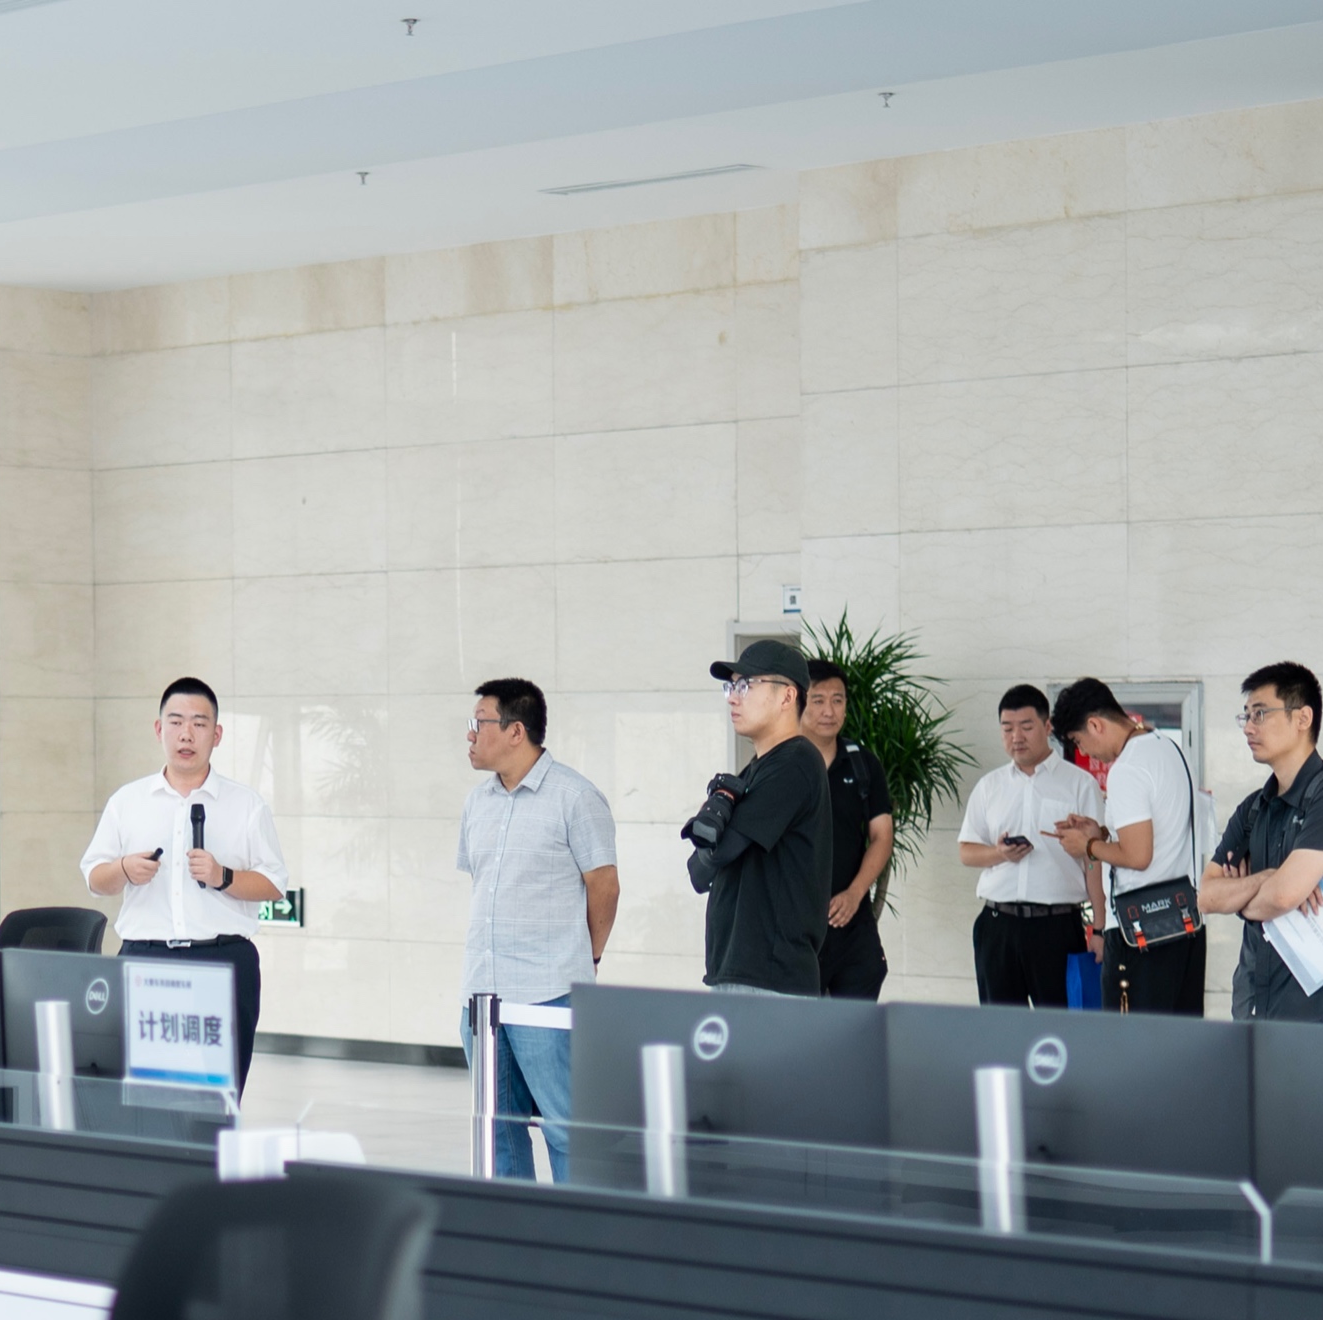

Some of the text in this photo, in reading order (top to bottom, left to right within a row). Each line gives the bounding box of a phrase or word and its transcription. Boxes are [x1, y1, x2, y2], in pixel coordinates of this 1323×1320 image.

[1141, 898, 1172, 912] MARK
[88, 990, 105, 1002] DELL
[138, 1011, 222, 1047] 计划调度
